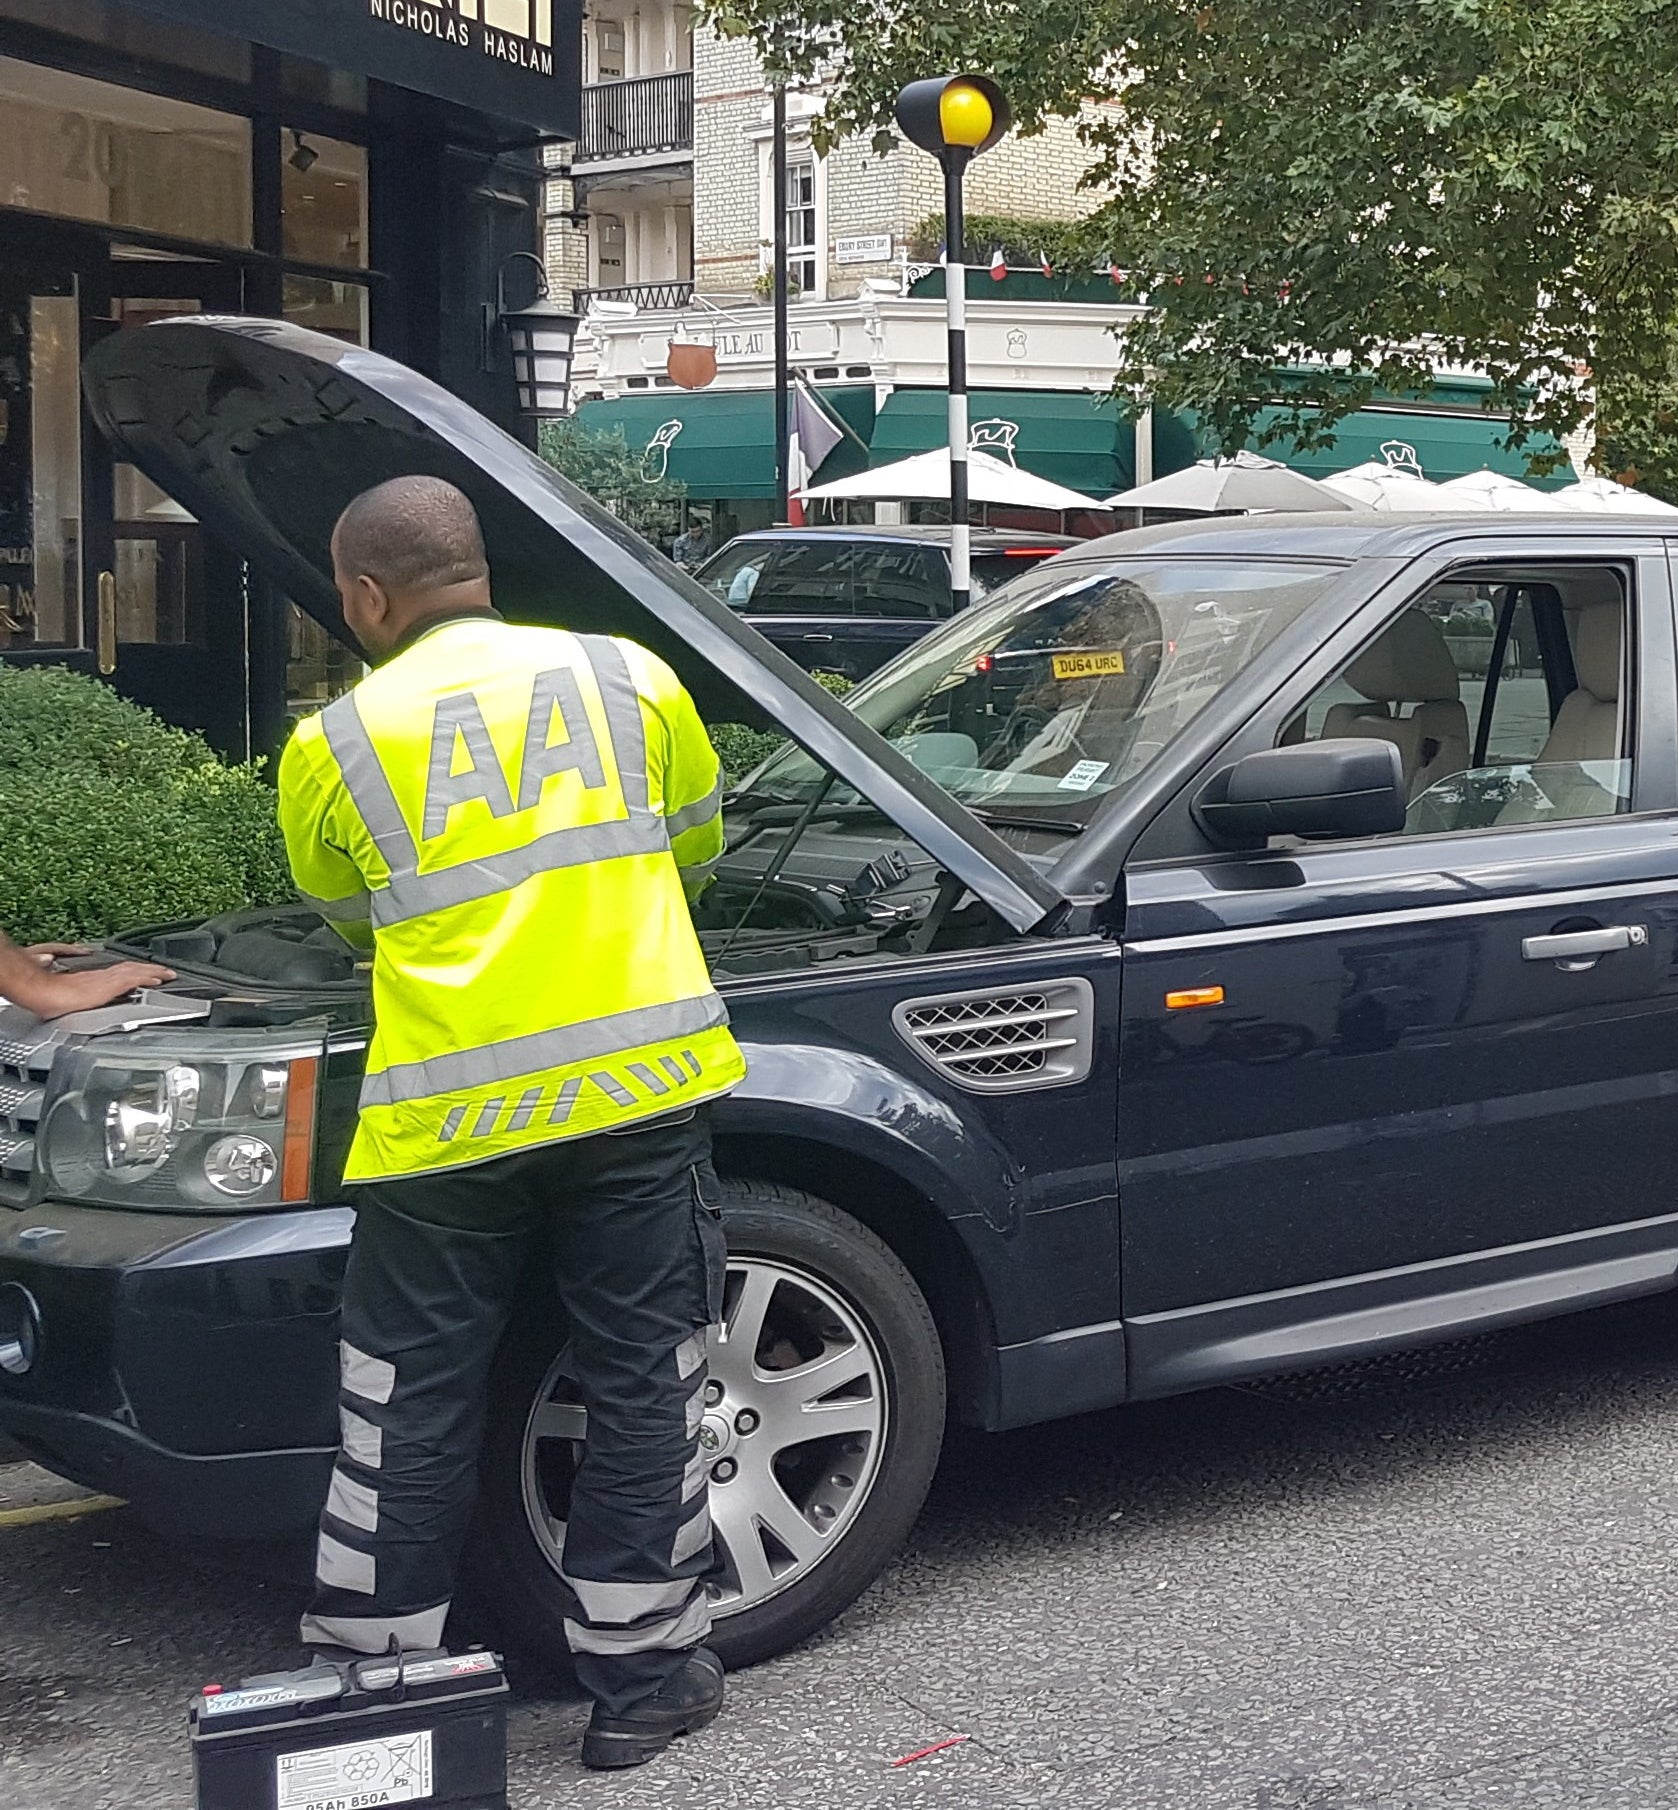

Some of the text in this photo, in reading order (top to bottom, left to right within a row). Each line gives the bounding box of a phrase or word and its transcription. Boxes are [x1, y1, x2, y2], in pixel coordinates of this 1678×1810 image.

[370, 0, 469, 46] NICHOLAS
[484, 30, 552, 76] HASLAM
[1057, 656, 1118, 673] DU64 URC
[421, 665, 607, 842] AA
[351, 1791, 390, 1808] 850A
